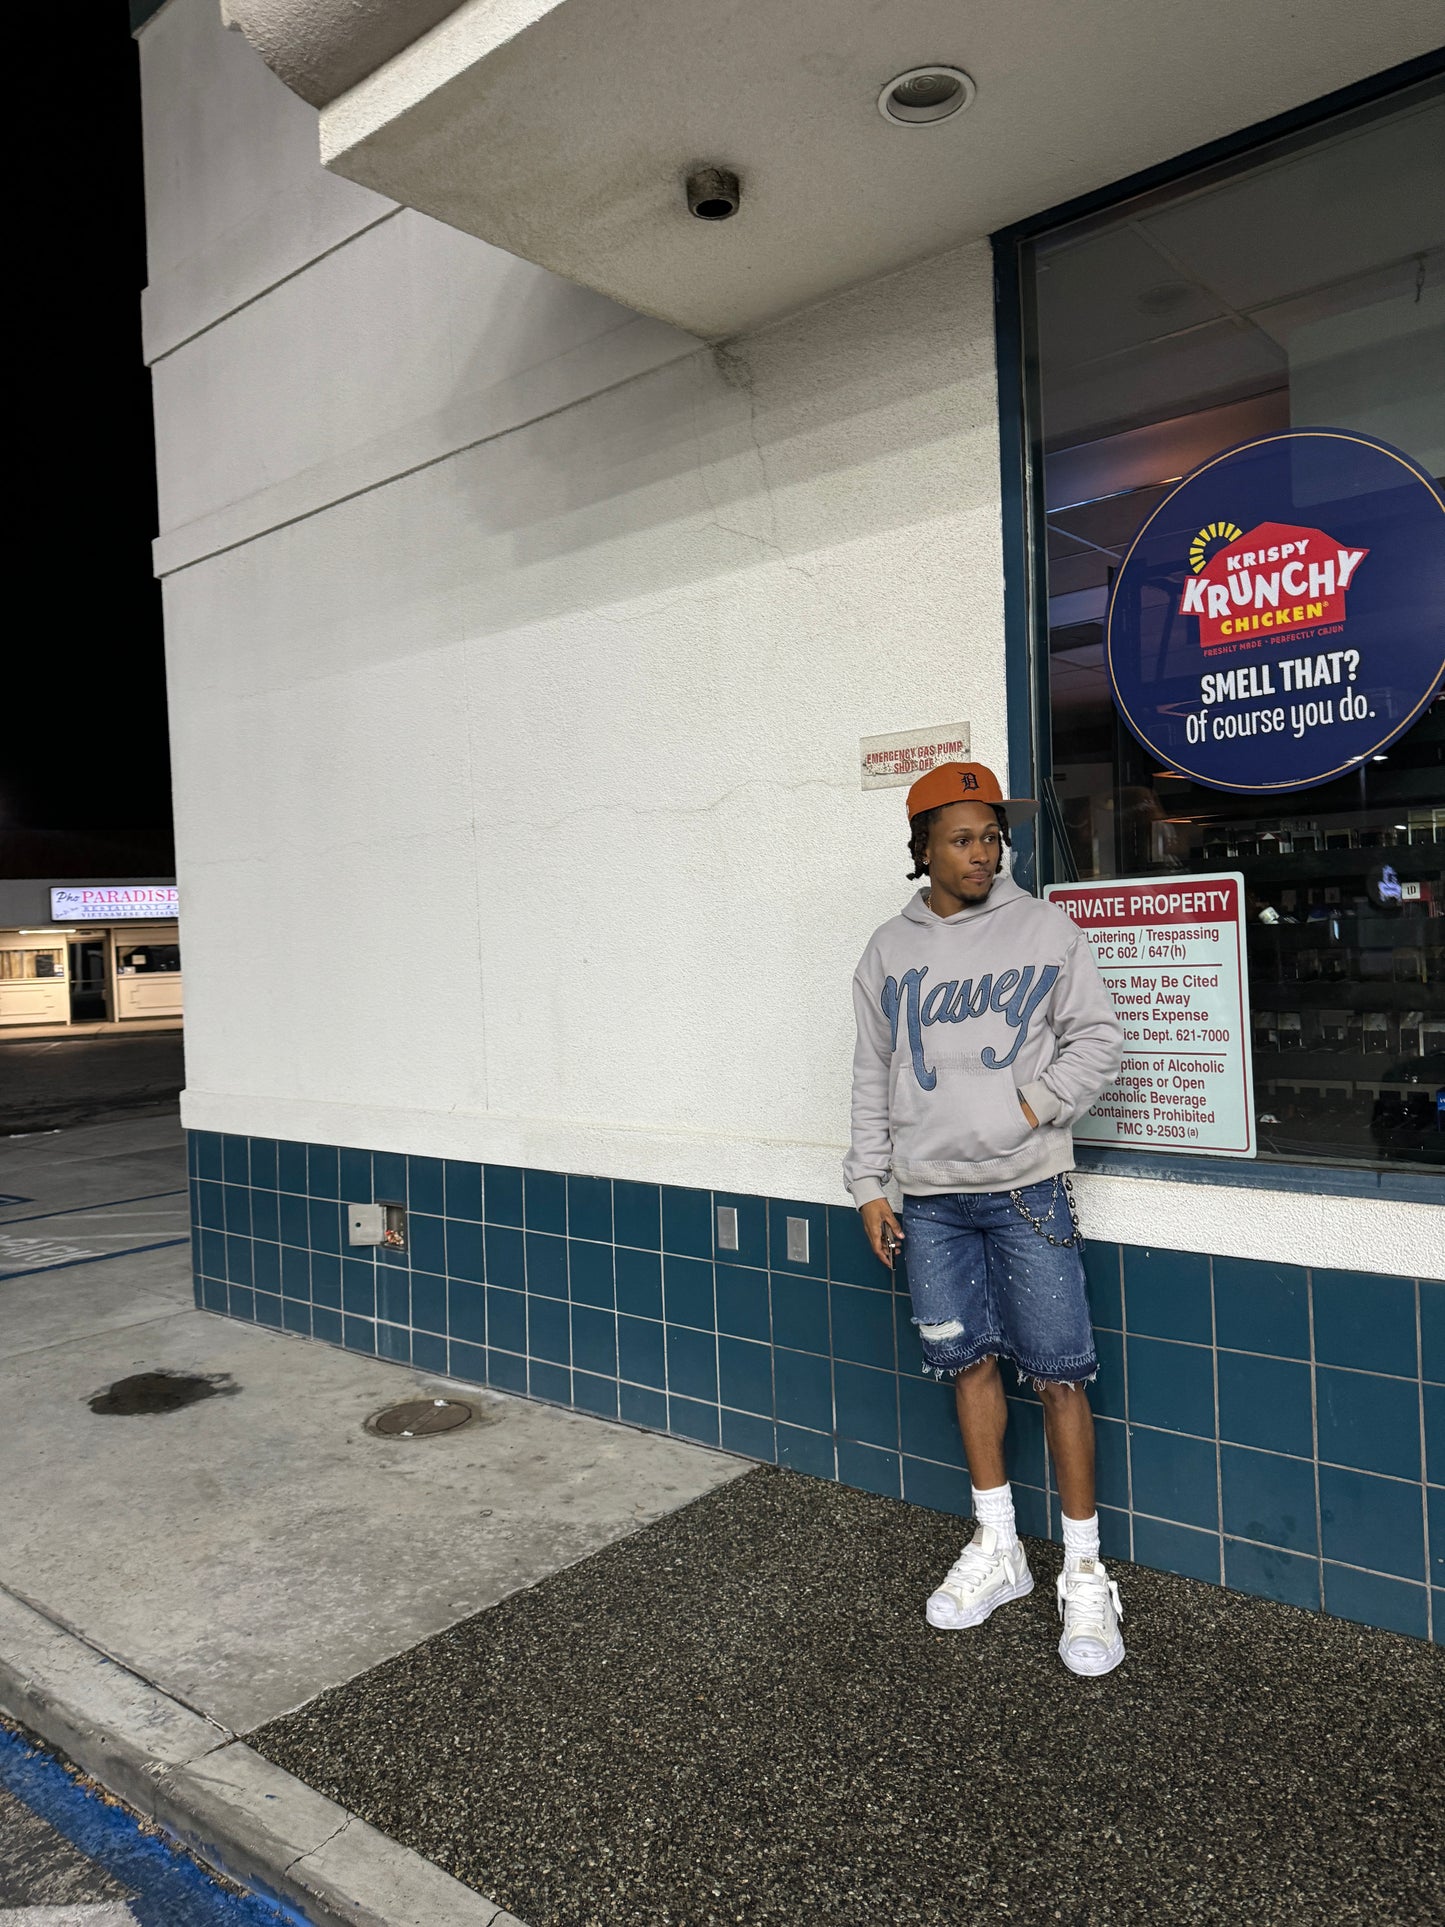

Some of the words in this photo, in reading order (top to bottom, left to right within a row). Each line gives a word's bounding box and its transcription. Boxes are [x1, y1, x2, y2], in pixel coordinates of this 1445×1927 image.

[1226, 539, 1310, 571] KRISPY
[1182, 549, 1364, 619] KRUNCHY
[1203, 644, 1237, 657] FRESHLY
[1239, 639, 1262, 651] MADE
[1270, 630, 1315, 645] PERFECTLY
[1317, 624, 1344, 637] CAJUN
[1201, 664, 1276, 705] SMELL
[1278, 649, 1361, 692] THAT?
[1186, 709, 1209, 744] Of
[1212, 707, 1285, 740] course
[1291, 700, 1334, 738] you
[1339, 686, 1376, 721] do.
[867, 747, 916, 765] EMERGENCY
[917, 745, 936, 759] GAS
[937, 740, 964, 755] PUMP
[81, 888, 179, 903] PARADISE
[1130, 890, 1231, 916] PROPERTY
[1086, 929, 1136, 945] Loitering
[1139, 929, 1144, 942] /
[1146, 927, 1220, 943] Trespassing
[1098, 947, 1114, 959] PC
[1117, 946, 1138, 959] 602
[1140, 945, 1146, 960] /
[1149, 945, 1187, 960] 647(h)
[1131, 976, 1157, 991] May
[1161, 976, 1179, 988] Be
[1183, 974, 1219, 988] Cited
[1111, 992, 1151, 1004] Towed
[1155, 991, 1191, 1007] Away
[1152, 1008, 1209, 1024] Expense
[1143, 1028, 1173, 1044] Dept.
[1176, 1028, 1230, 1042] 621-7000
[1153, 1059, 1165, 1071] of
[1168, 1059, 1225, 1073] Alcoholic
[1157, 1078, 1169, 1088] or
[1172, 1076, 1205, 1091] Open
[1150, 1091, 1207, 1109] Beverage
[1088, 1105, 1150, 1120] Containers
[1153, 1109, 1215, 1124] Prohibited
[1116, 1122, 1143, 1136] FMC
[1146, 1124, 1186, 1138] 9-2503
[1187, 1127, 1199, 1139] (a)
